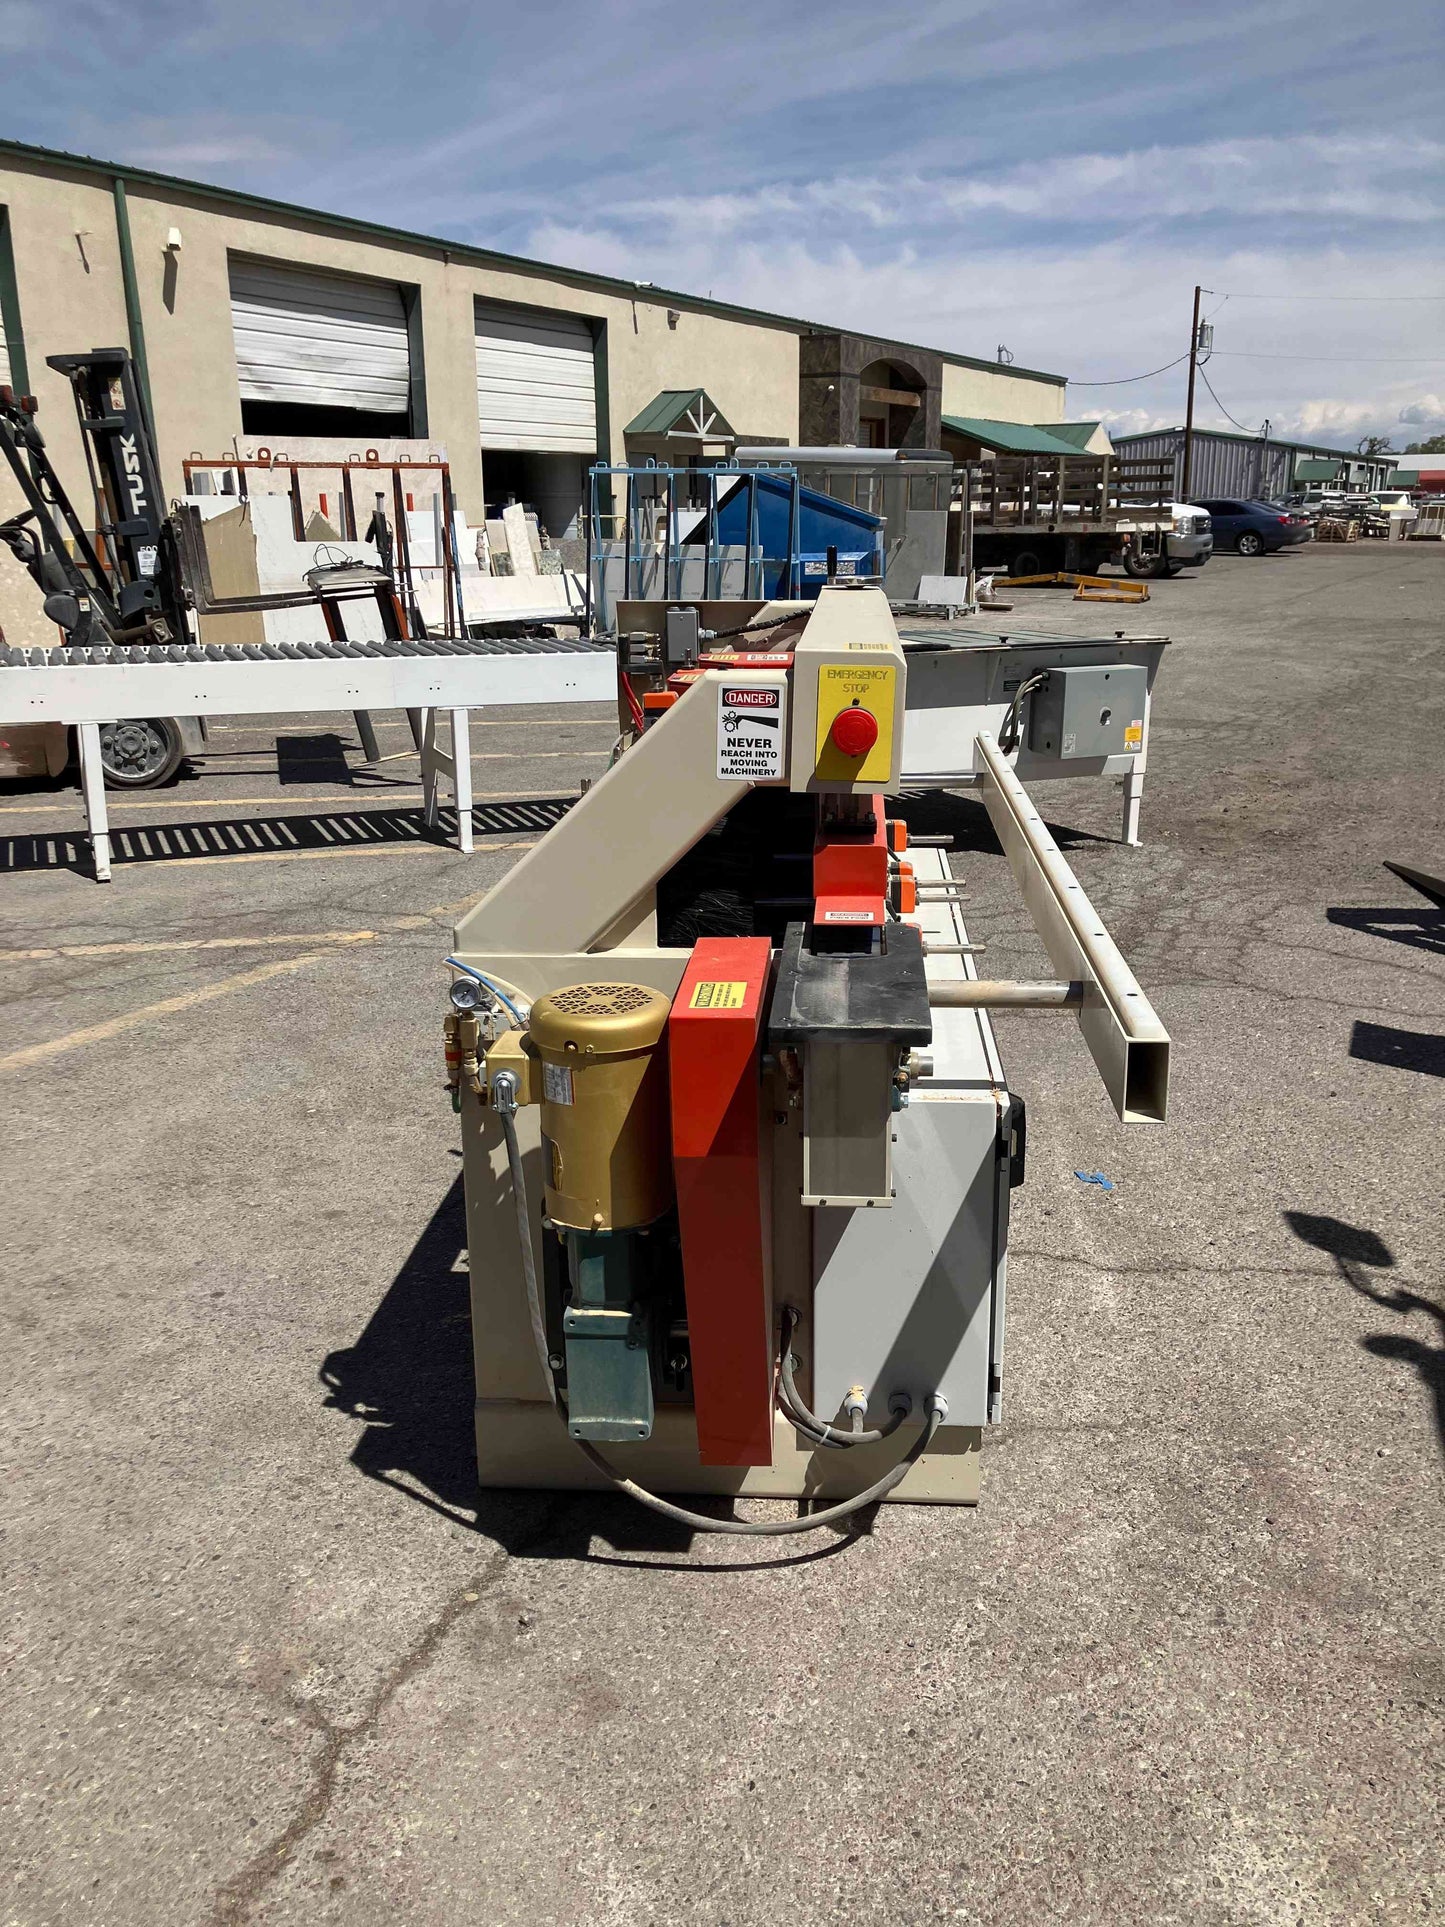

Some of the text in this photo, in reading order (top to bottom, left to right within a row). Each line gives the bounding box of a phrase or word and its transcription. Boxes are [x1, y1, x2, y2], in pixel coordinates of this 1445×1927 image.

[119, 433, 147, 515] TUSK
[827, 669, 889, 680] EMERGENCY
[843, 683, 870, 693] STOP
[728, 692, 774, 704] DANGER
[727, 737, 772, 749] NEVER
[720, 749, 778, 759] REACH INTO
[730, 759, 768, 767] MOVING
[720, 767, 777, 776] MACHINERY
